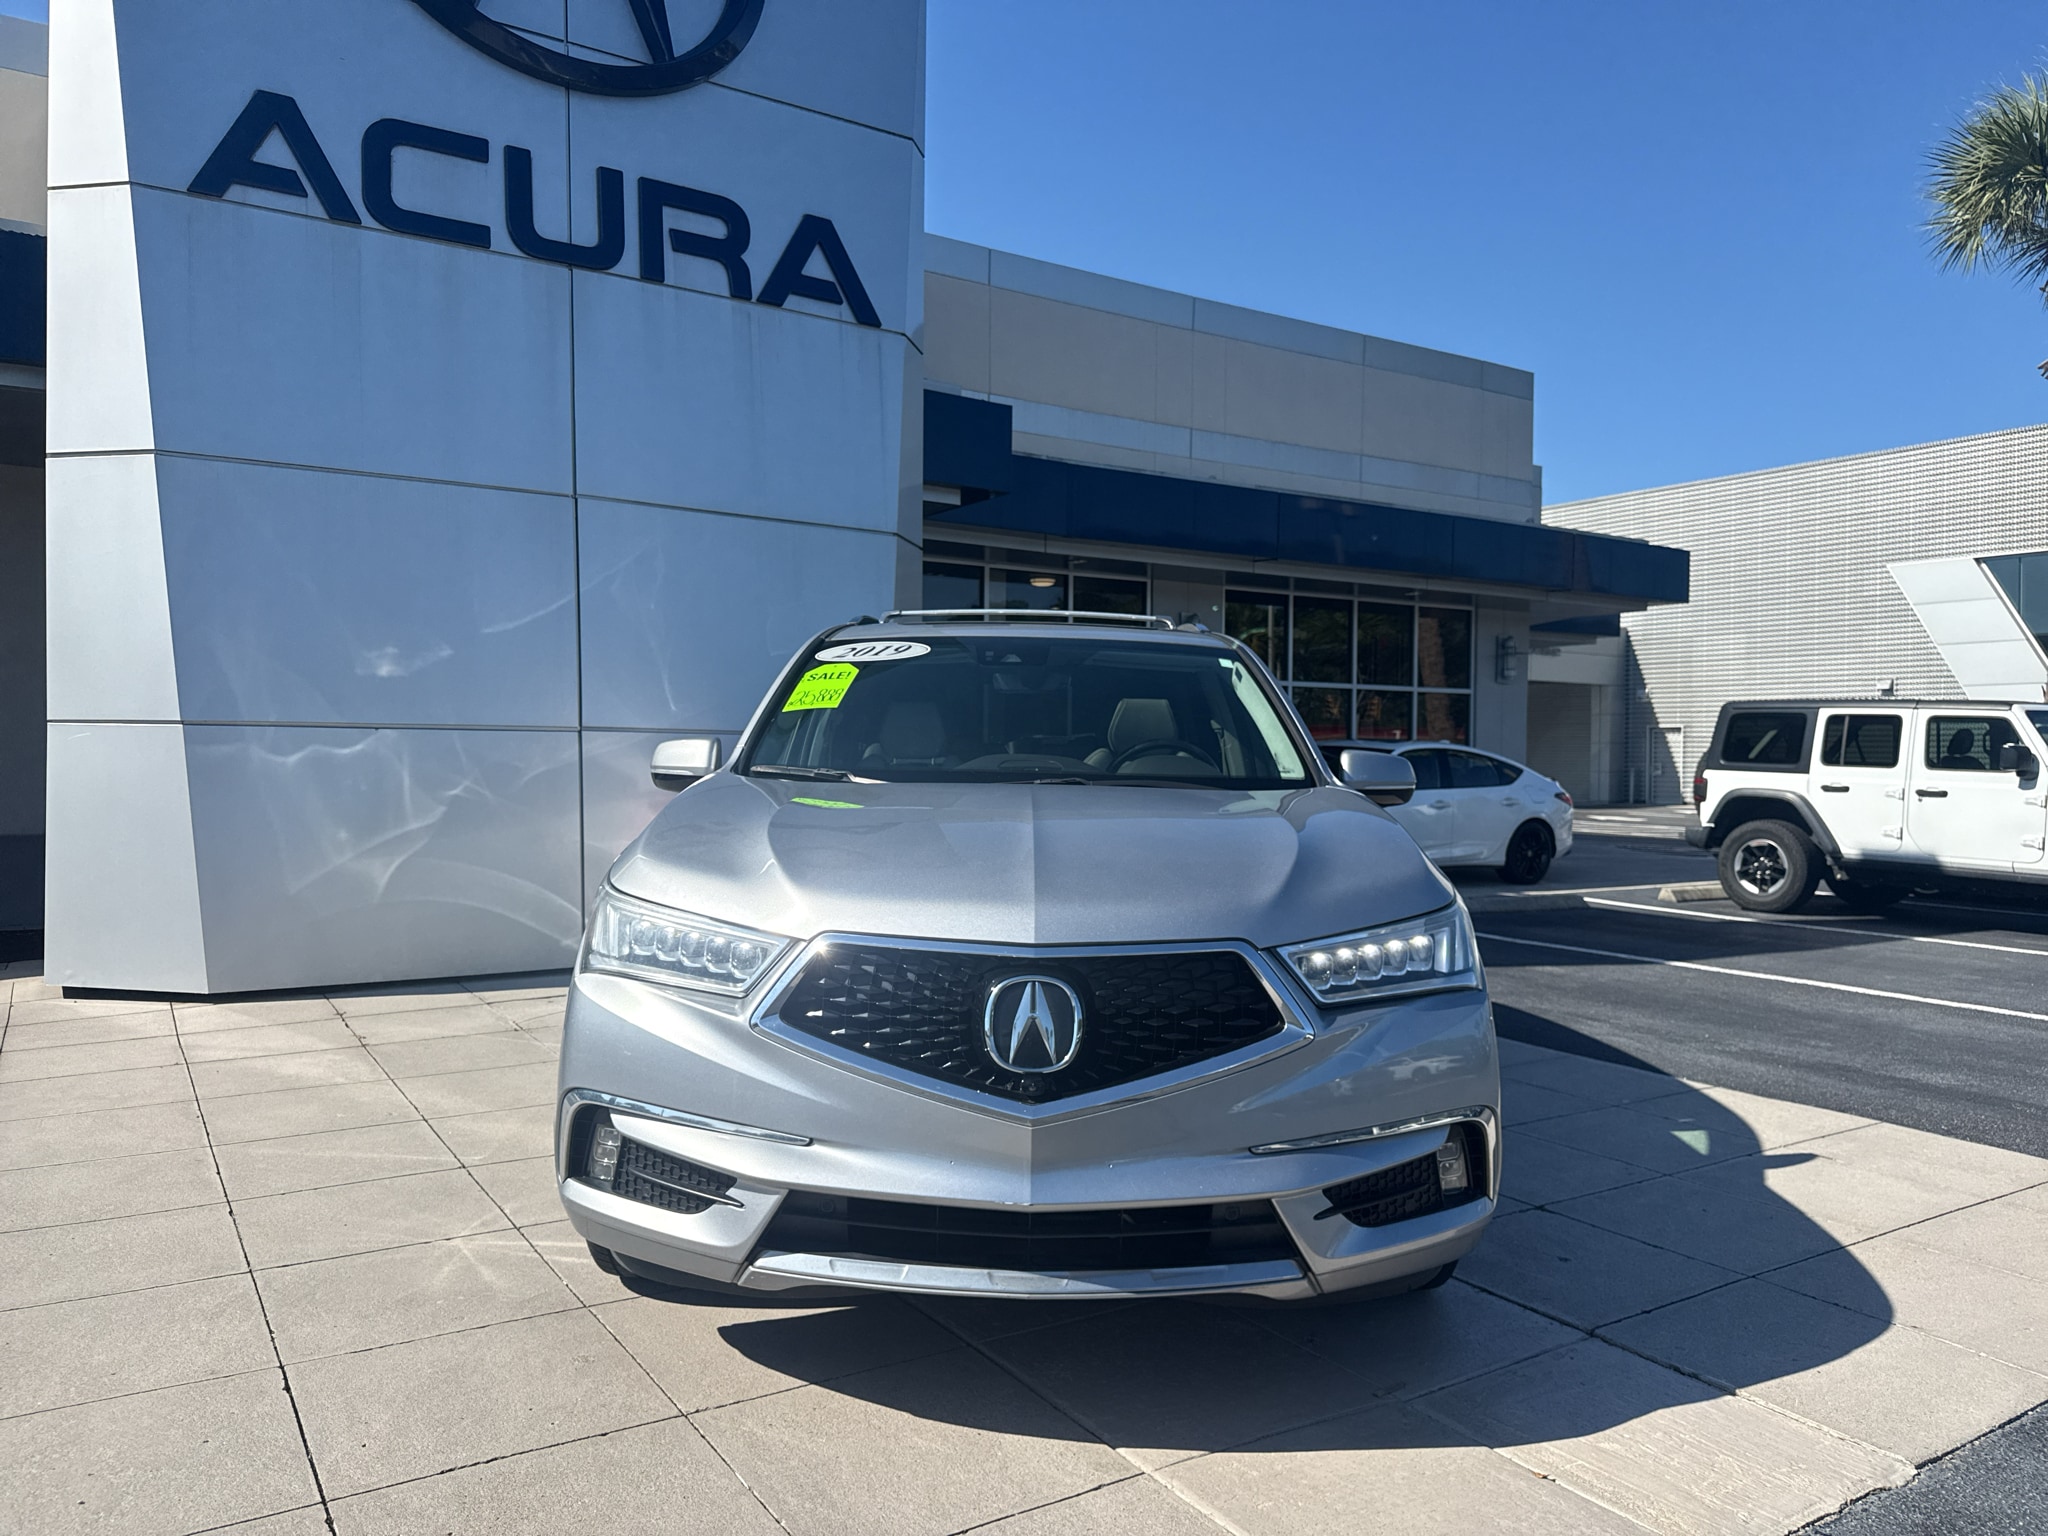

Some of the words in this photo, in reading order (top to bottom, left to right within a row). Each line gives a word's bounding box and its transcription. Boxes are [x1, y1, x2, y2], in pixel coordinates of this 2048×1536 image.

[187, 89, 882, 328] ACURA
[832, 645, 912, 659] 2019
[807, 671, 852, 682] SALE!
